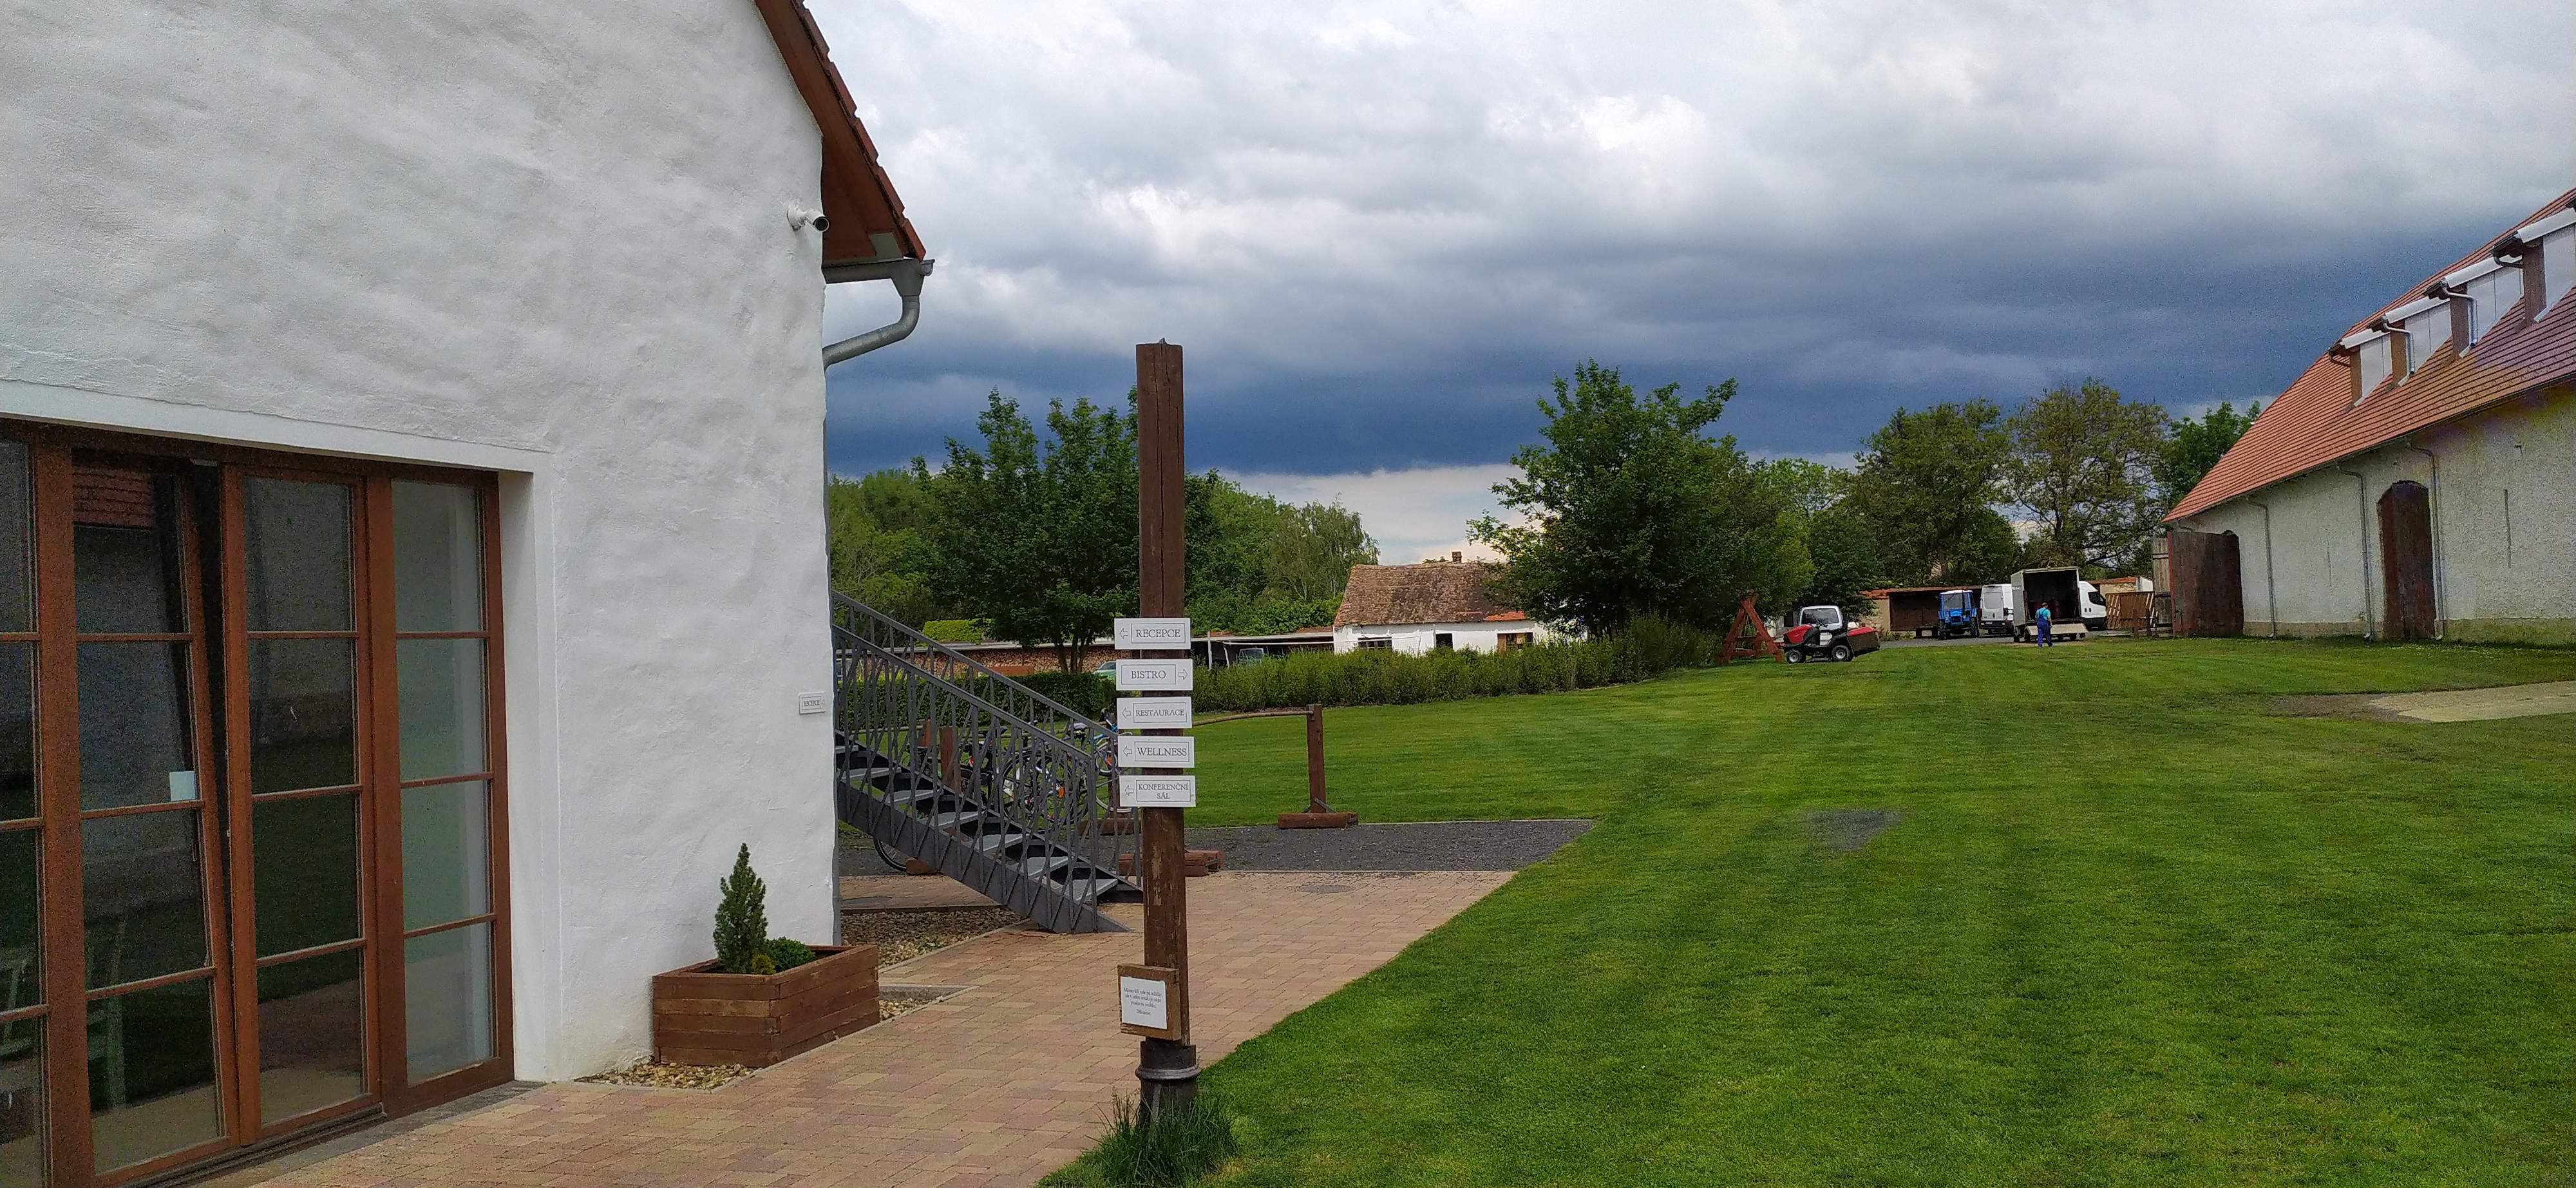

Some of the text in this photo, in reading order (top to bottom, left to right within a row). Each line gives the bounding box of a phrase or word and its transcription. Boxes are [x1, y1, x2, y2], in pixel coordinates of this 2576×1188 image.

[1135, 629, 1180, 638] RECEPCE
[1131, 670, 1166, 679] BISTRO
[1137, 747, 1187, 756] WELLNESS
[1138, 781, 1189, 790] KONFERENČNÍ
[1157, 791, 1170, 800] SÁL
